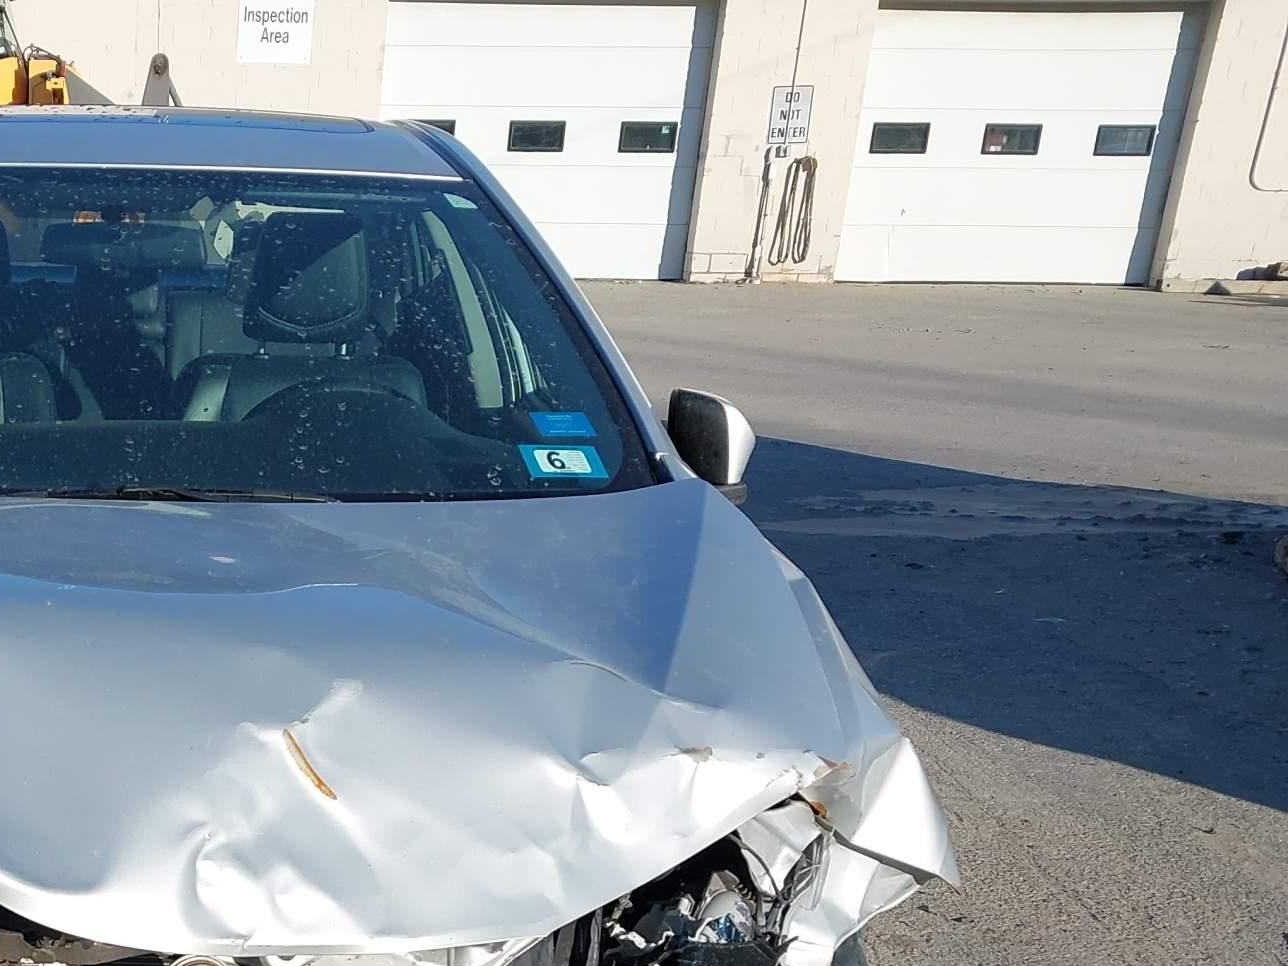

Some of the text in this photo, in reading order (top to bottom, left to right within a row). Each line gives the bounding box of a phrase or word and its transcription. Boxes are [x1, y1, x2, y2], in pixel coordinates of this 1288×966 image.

[244, 6, 309, 26] Inspection
[260, 27, 289, 43] Area
[785, 91, 800, 103] DO
[546, 451, 566, 469] 6
